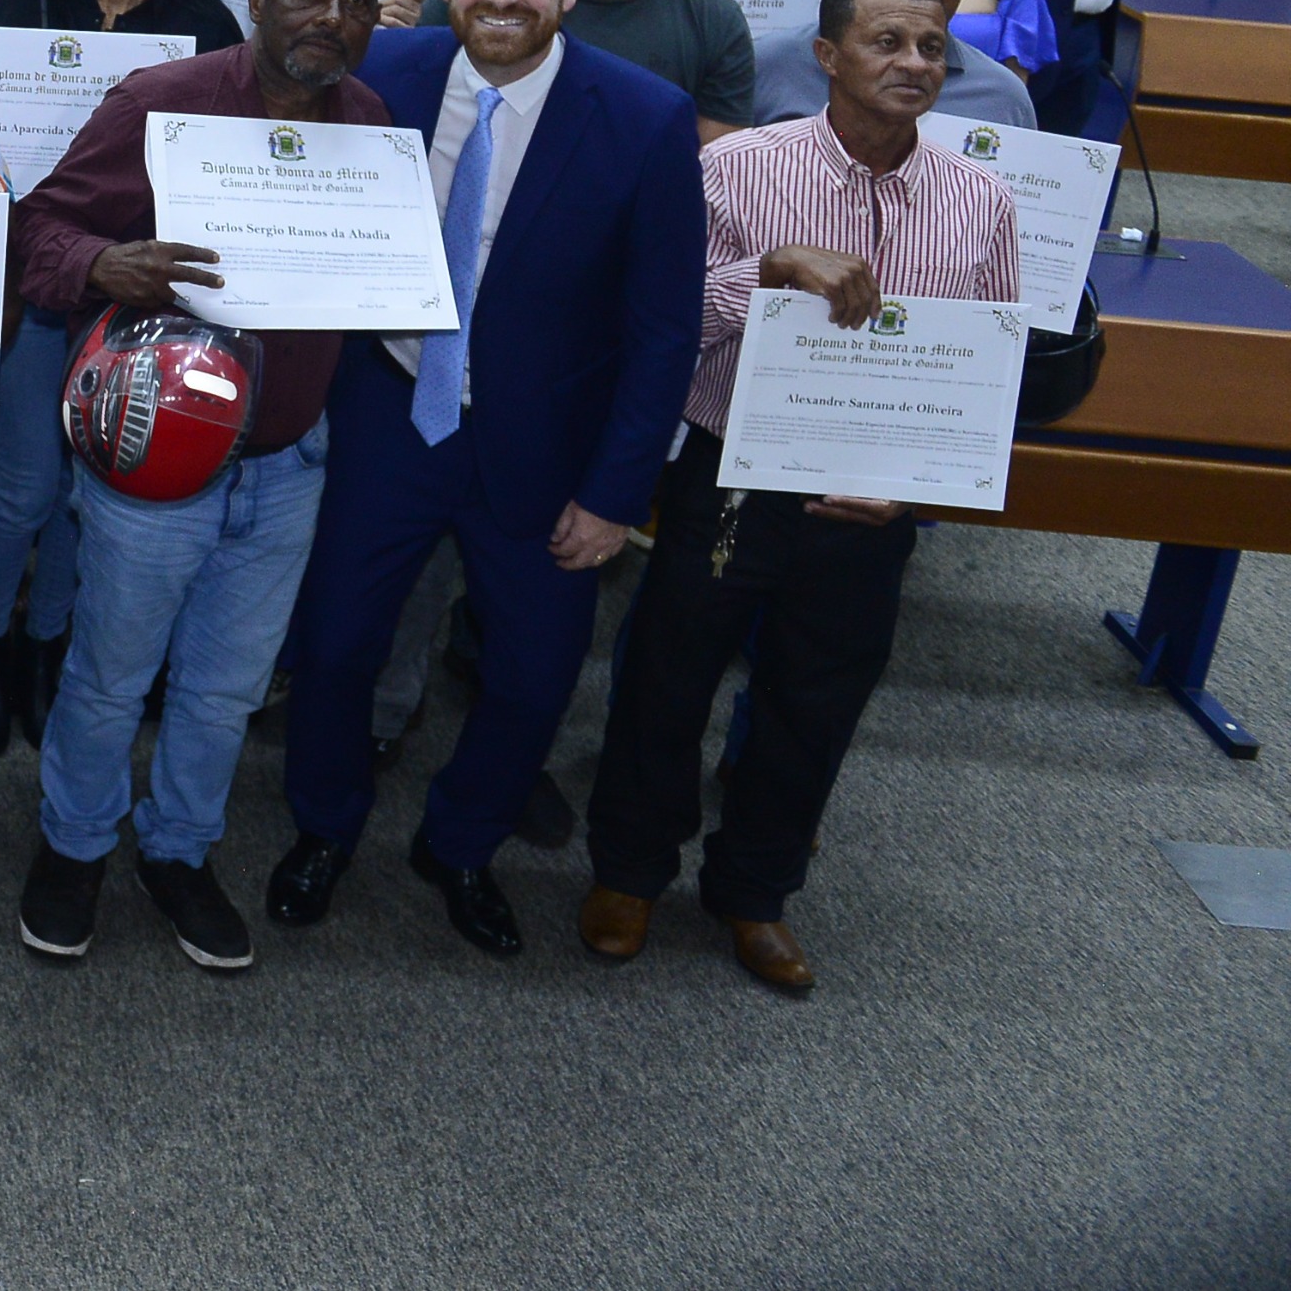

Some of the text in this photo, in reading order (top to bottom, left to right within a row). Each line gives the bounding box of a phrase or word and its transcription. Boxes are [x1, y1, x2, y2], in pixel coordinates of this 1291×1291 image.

[205, 221, 244, 233] Carlos
[287, 225, 328, 237] Ramos
[330, 228, 345, 239] da
[349, 228, 391, 240] Abadia
[1019, 232, 1074, 249] de Oliveira
[795, 335, 974, 358] Diploma de Honra ao Mérito
[809, 351, 954, 370] Câmara Municipal de Goiânia
[785, 393, 963, 417] Alexandre Santana de Oliveira
